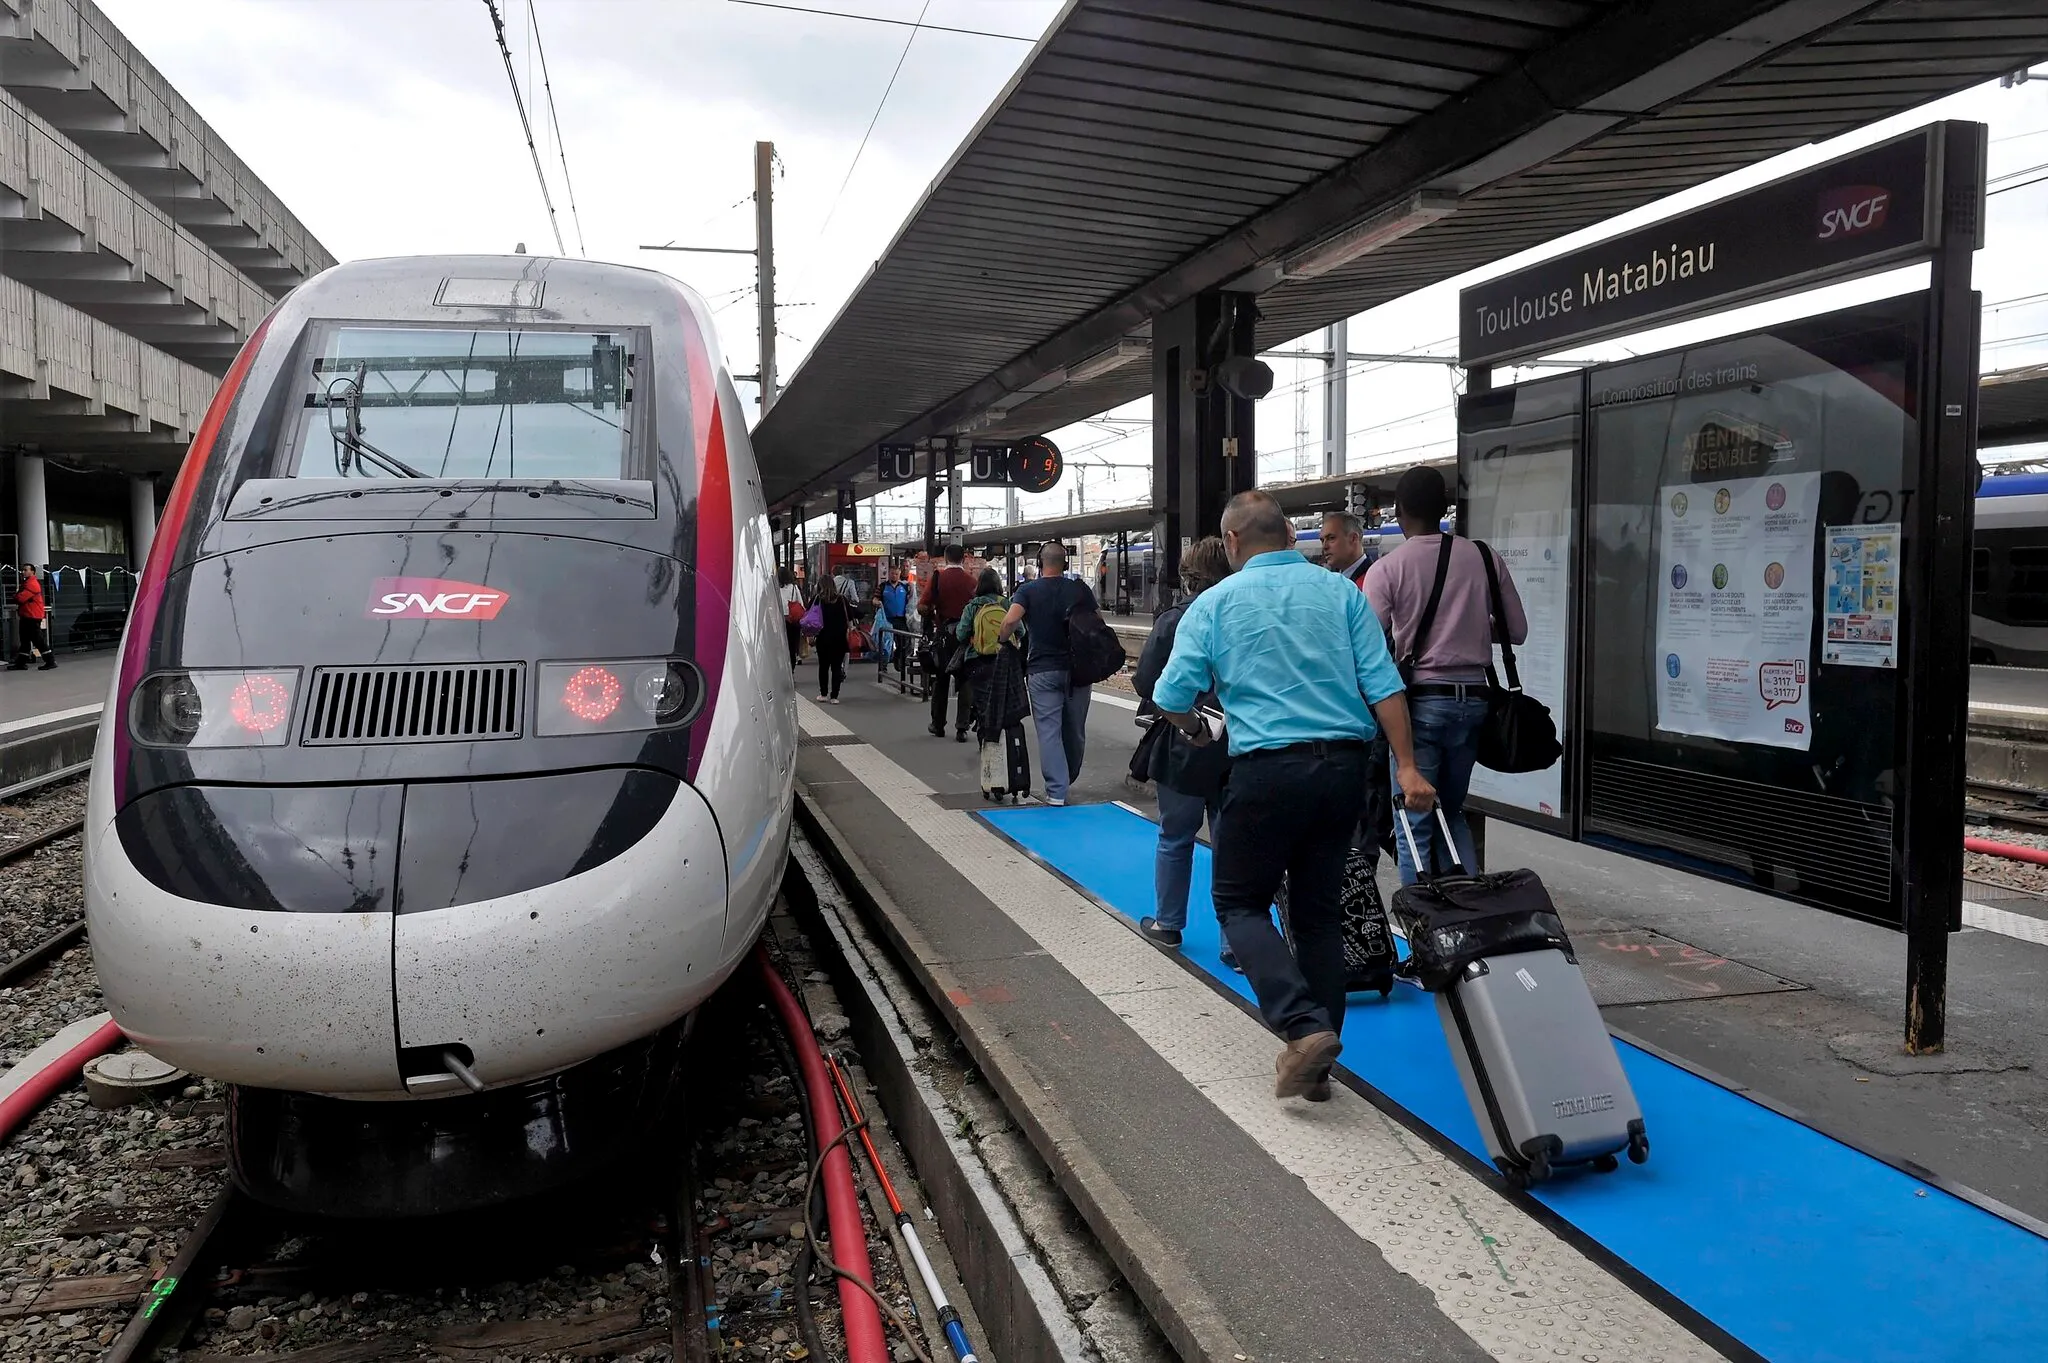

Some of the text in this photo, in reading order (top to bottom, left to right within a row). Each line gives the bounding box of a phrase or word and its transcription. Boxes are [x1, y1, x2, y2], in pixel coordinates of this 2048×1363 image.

[1819, 194, 1888, 238] SNCF
[1476, 242, 1715, 337] Toulouse Matabiau
[1602, 361, 1758, 406] Composition des trains
[895, 454, 914, 479] U
[973, 455, 992, 480] U
[1681, 446, 1758, 472] ENSEMBLE
[372, 593, 500, 614] SNCF
[1772, 676, 1791, 686] 3117
[1773, 687, 1796, 698] 31177
[1785, 723, 1803, 733] SNCF
